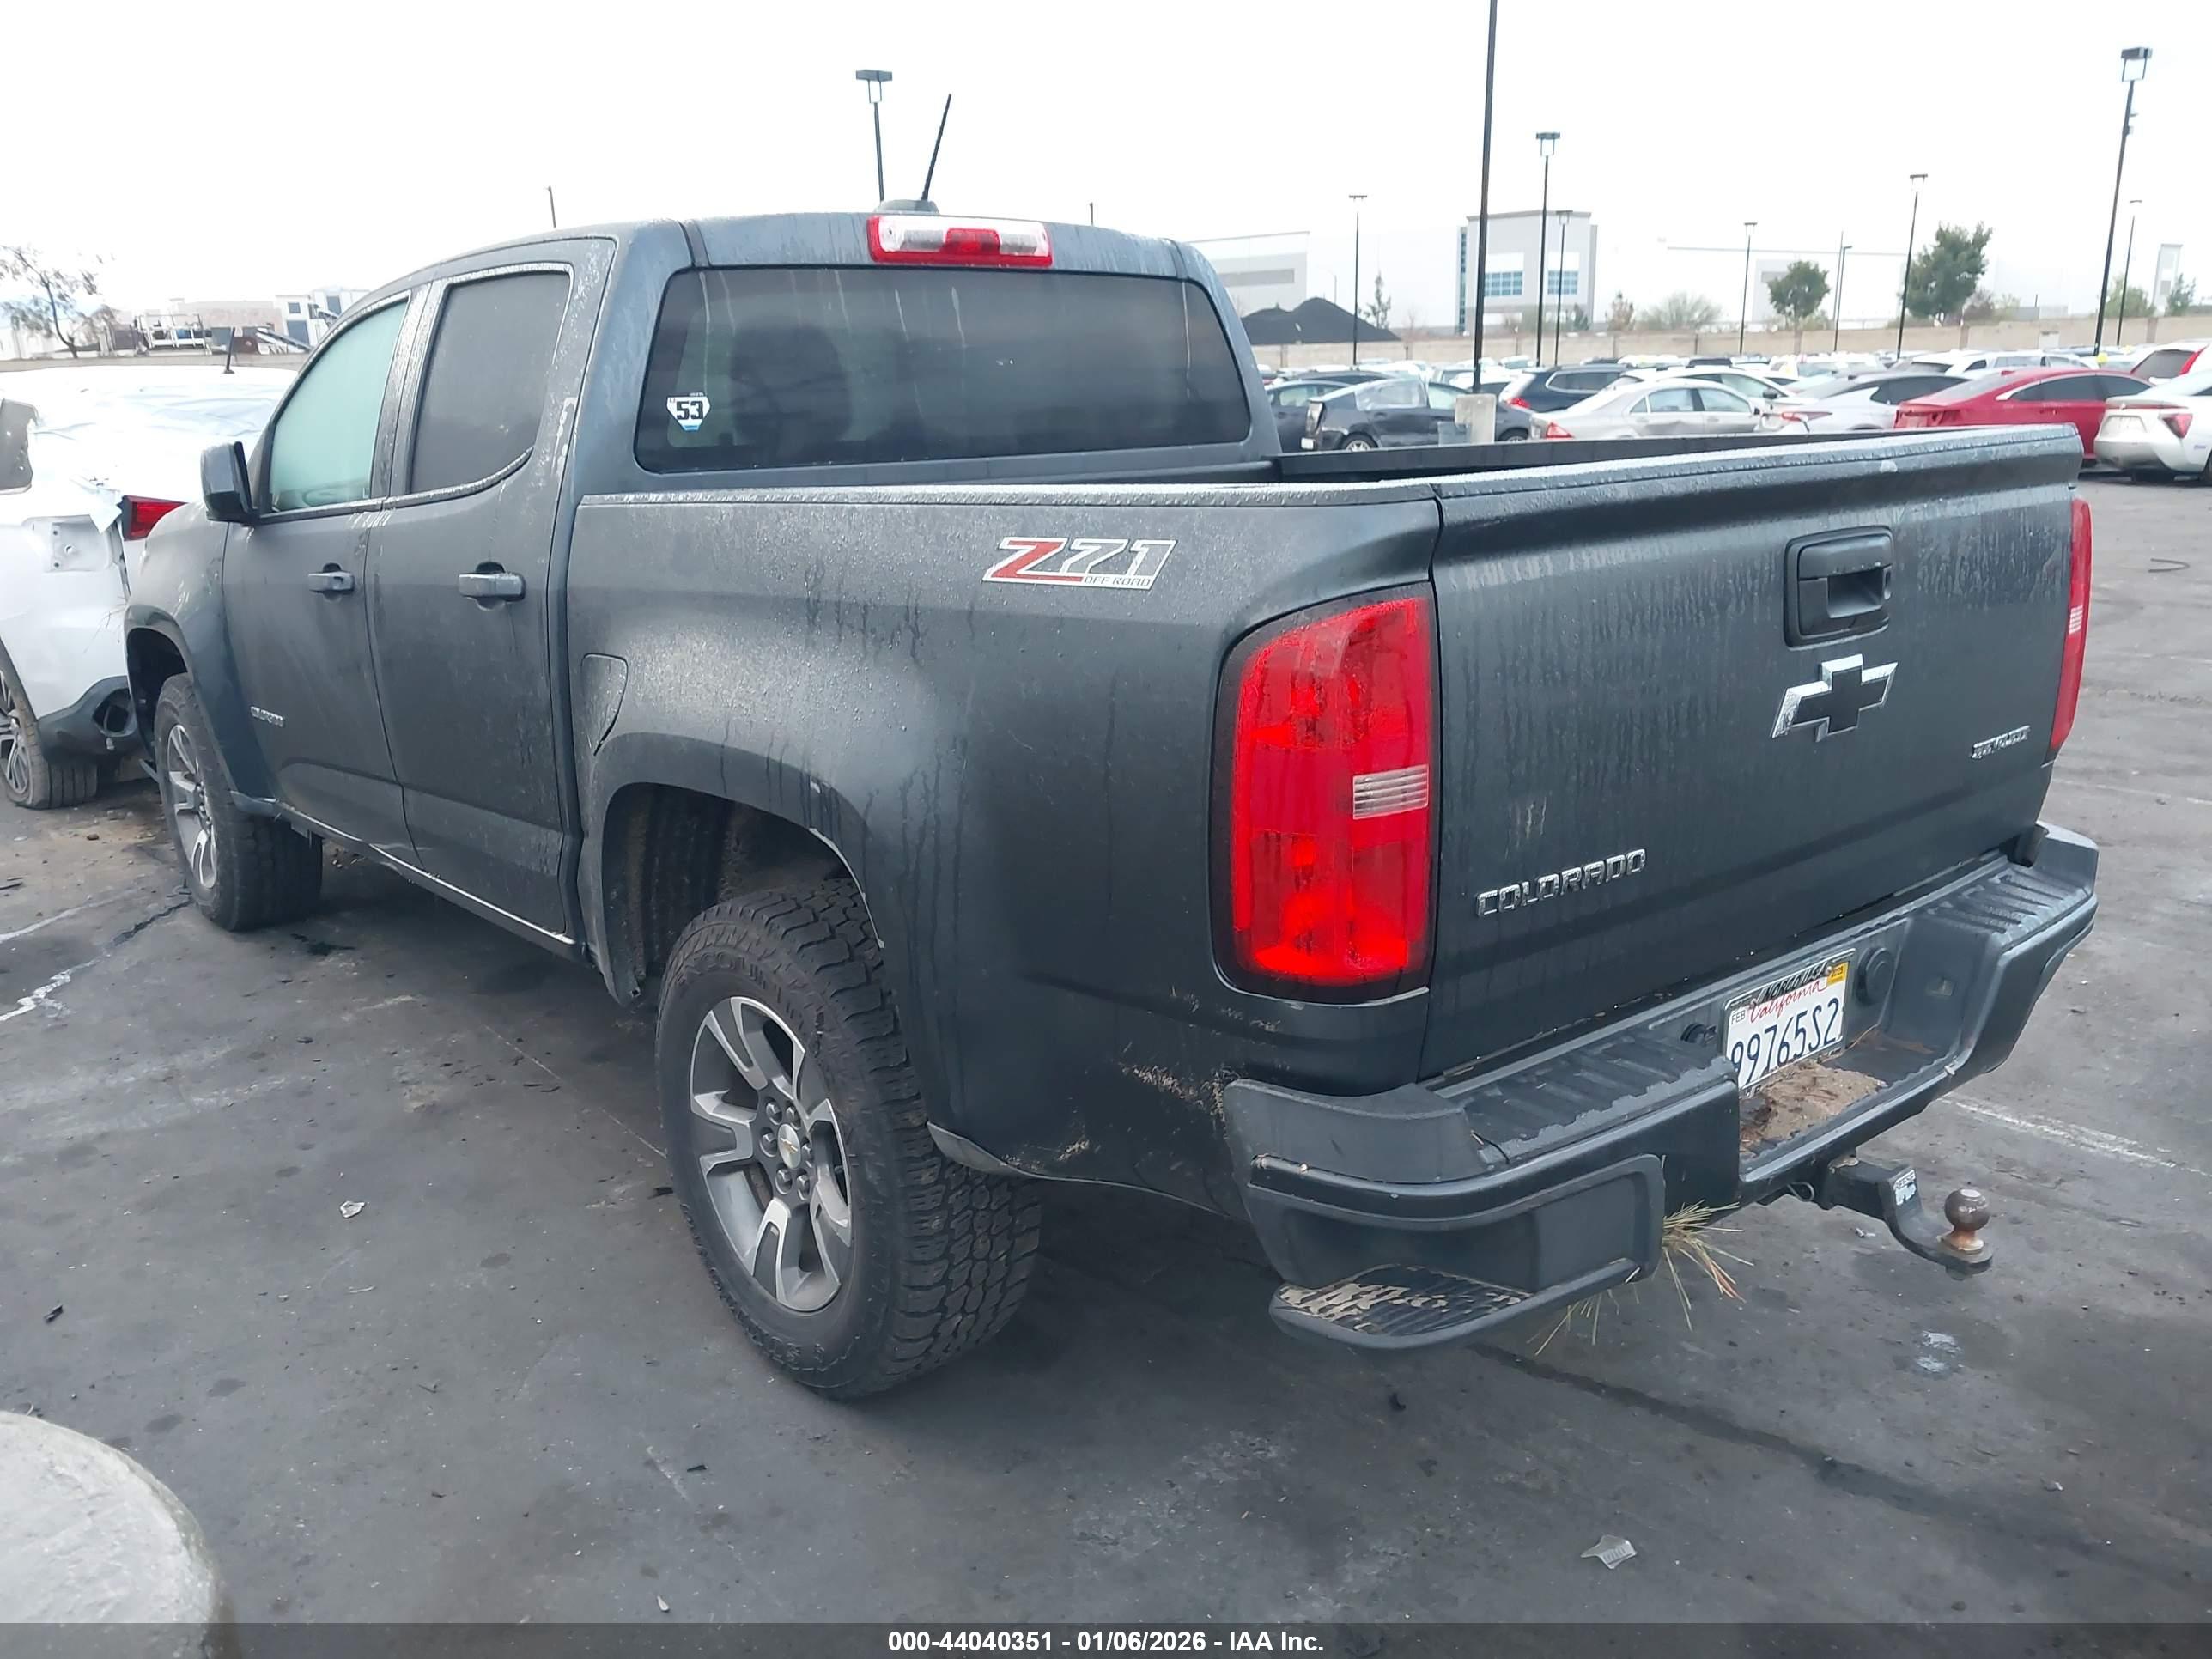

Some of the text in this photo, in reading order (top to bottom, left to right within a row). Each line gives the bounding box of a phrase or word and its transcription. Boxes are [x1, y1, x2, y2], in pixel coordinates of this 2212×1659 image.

[677, 401, 703, 420] 53
[982, 537, 1177, 584] Z71
[1085, 575, 1152, 586] OFF ROAD
[1477, 848, 1646, 916] COLORADO
[1730, 1009, 1746, 1024] FEB
[1749, 978, 1828, 1024] California
[1730, 997, 1839, 1085] 99765S2
